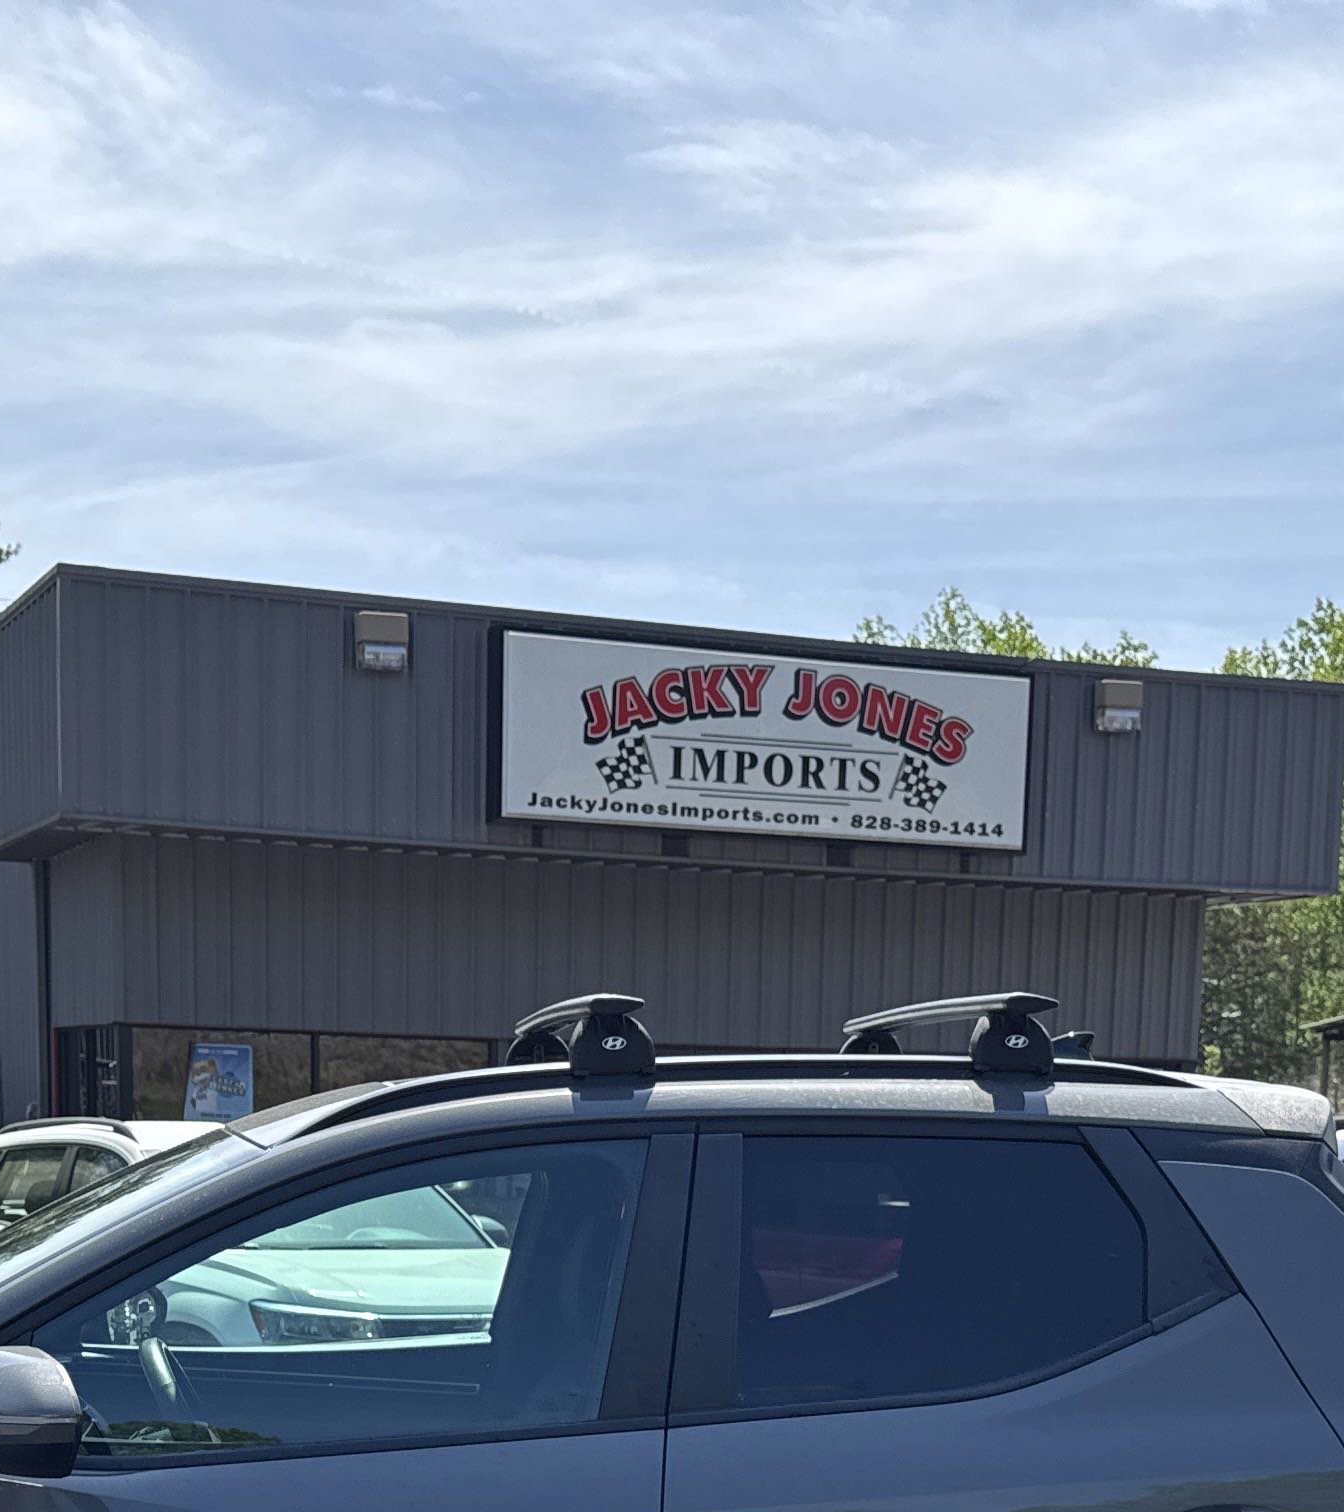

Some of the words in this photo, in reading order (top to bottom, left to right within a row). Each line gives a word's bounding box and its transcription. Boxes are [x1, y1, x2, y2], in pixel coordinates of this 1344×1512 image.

[581, 665, 774, 744] JACKY
[784, 669, 974, 765] JONES
[670, 745, 881, 793] IMPORTS
[527, 792, 820, 826] JackyJonesImports.com
[850, 815, 1004, 838] 828-389-1414
